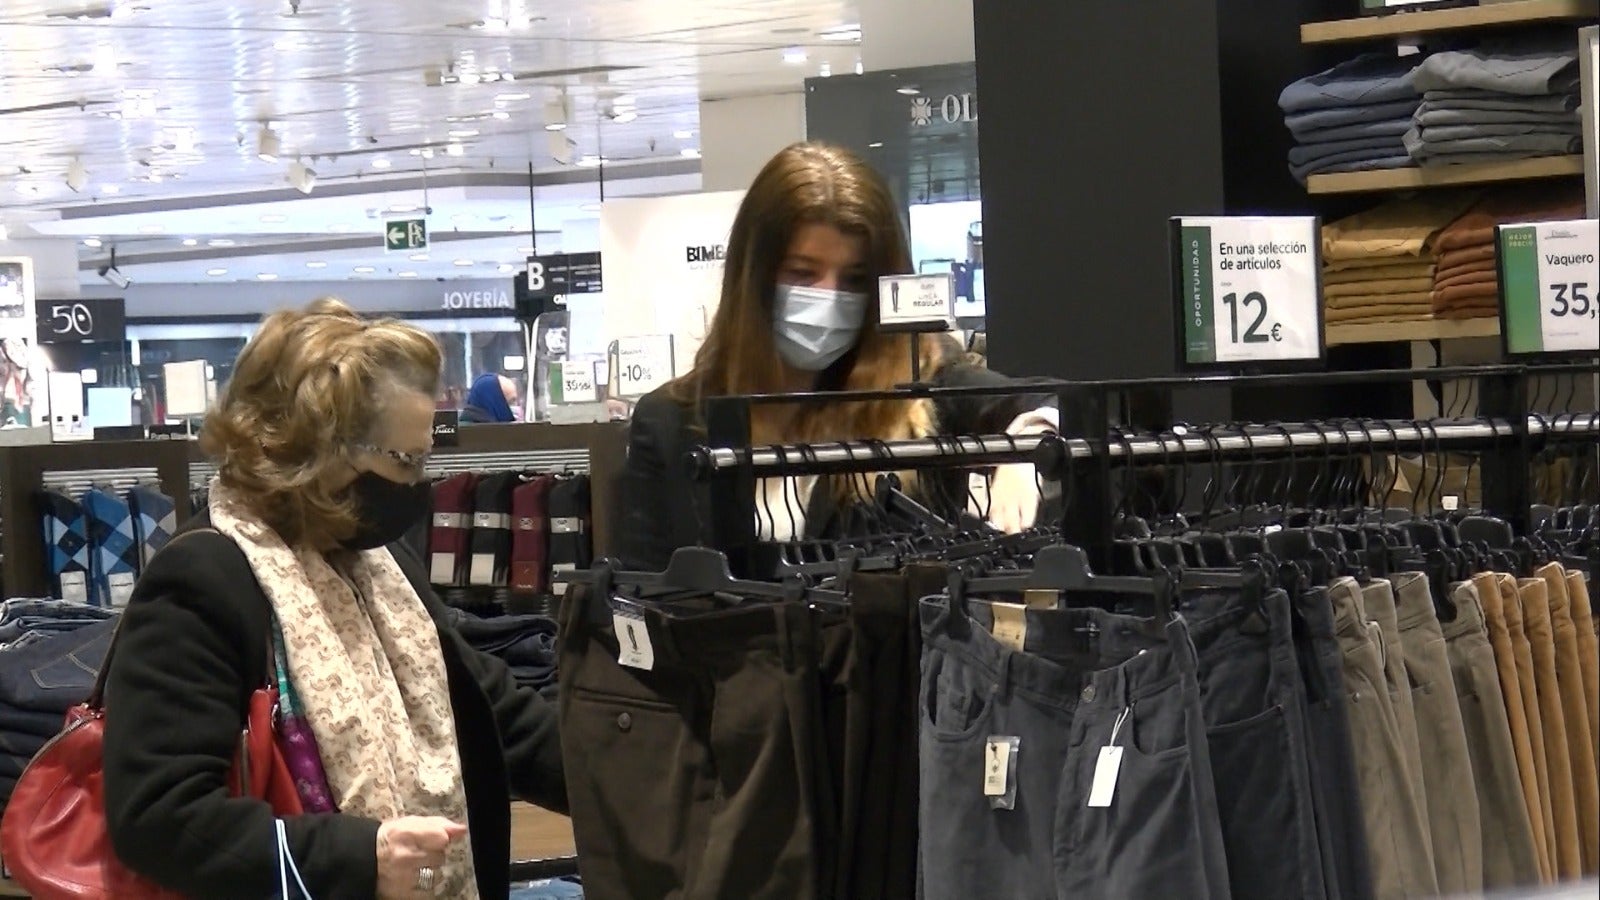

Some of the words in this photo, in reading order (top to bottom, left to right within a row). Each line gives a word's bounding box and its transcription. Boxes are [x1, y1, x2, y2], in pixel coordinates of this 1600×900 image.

[1219, 242, 1233, 255] En
[1236, 244, 1255, 255] una
[1257, 241, 1307, 255] selección
[1219, 258, 1233, 270] de
[1236, 256, 1281, 270] artículos
[1546, 253, 1594, 267] Vaquero
[527, 262, 545, 290] B
[1191, 239, 1202, 327] OPORTUNIDAD
[441, 288, 510, 309] JOYERÍA
[1549, 282, 1600, 319] 35,
